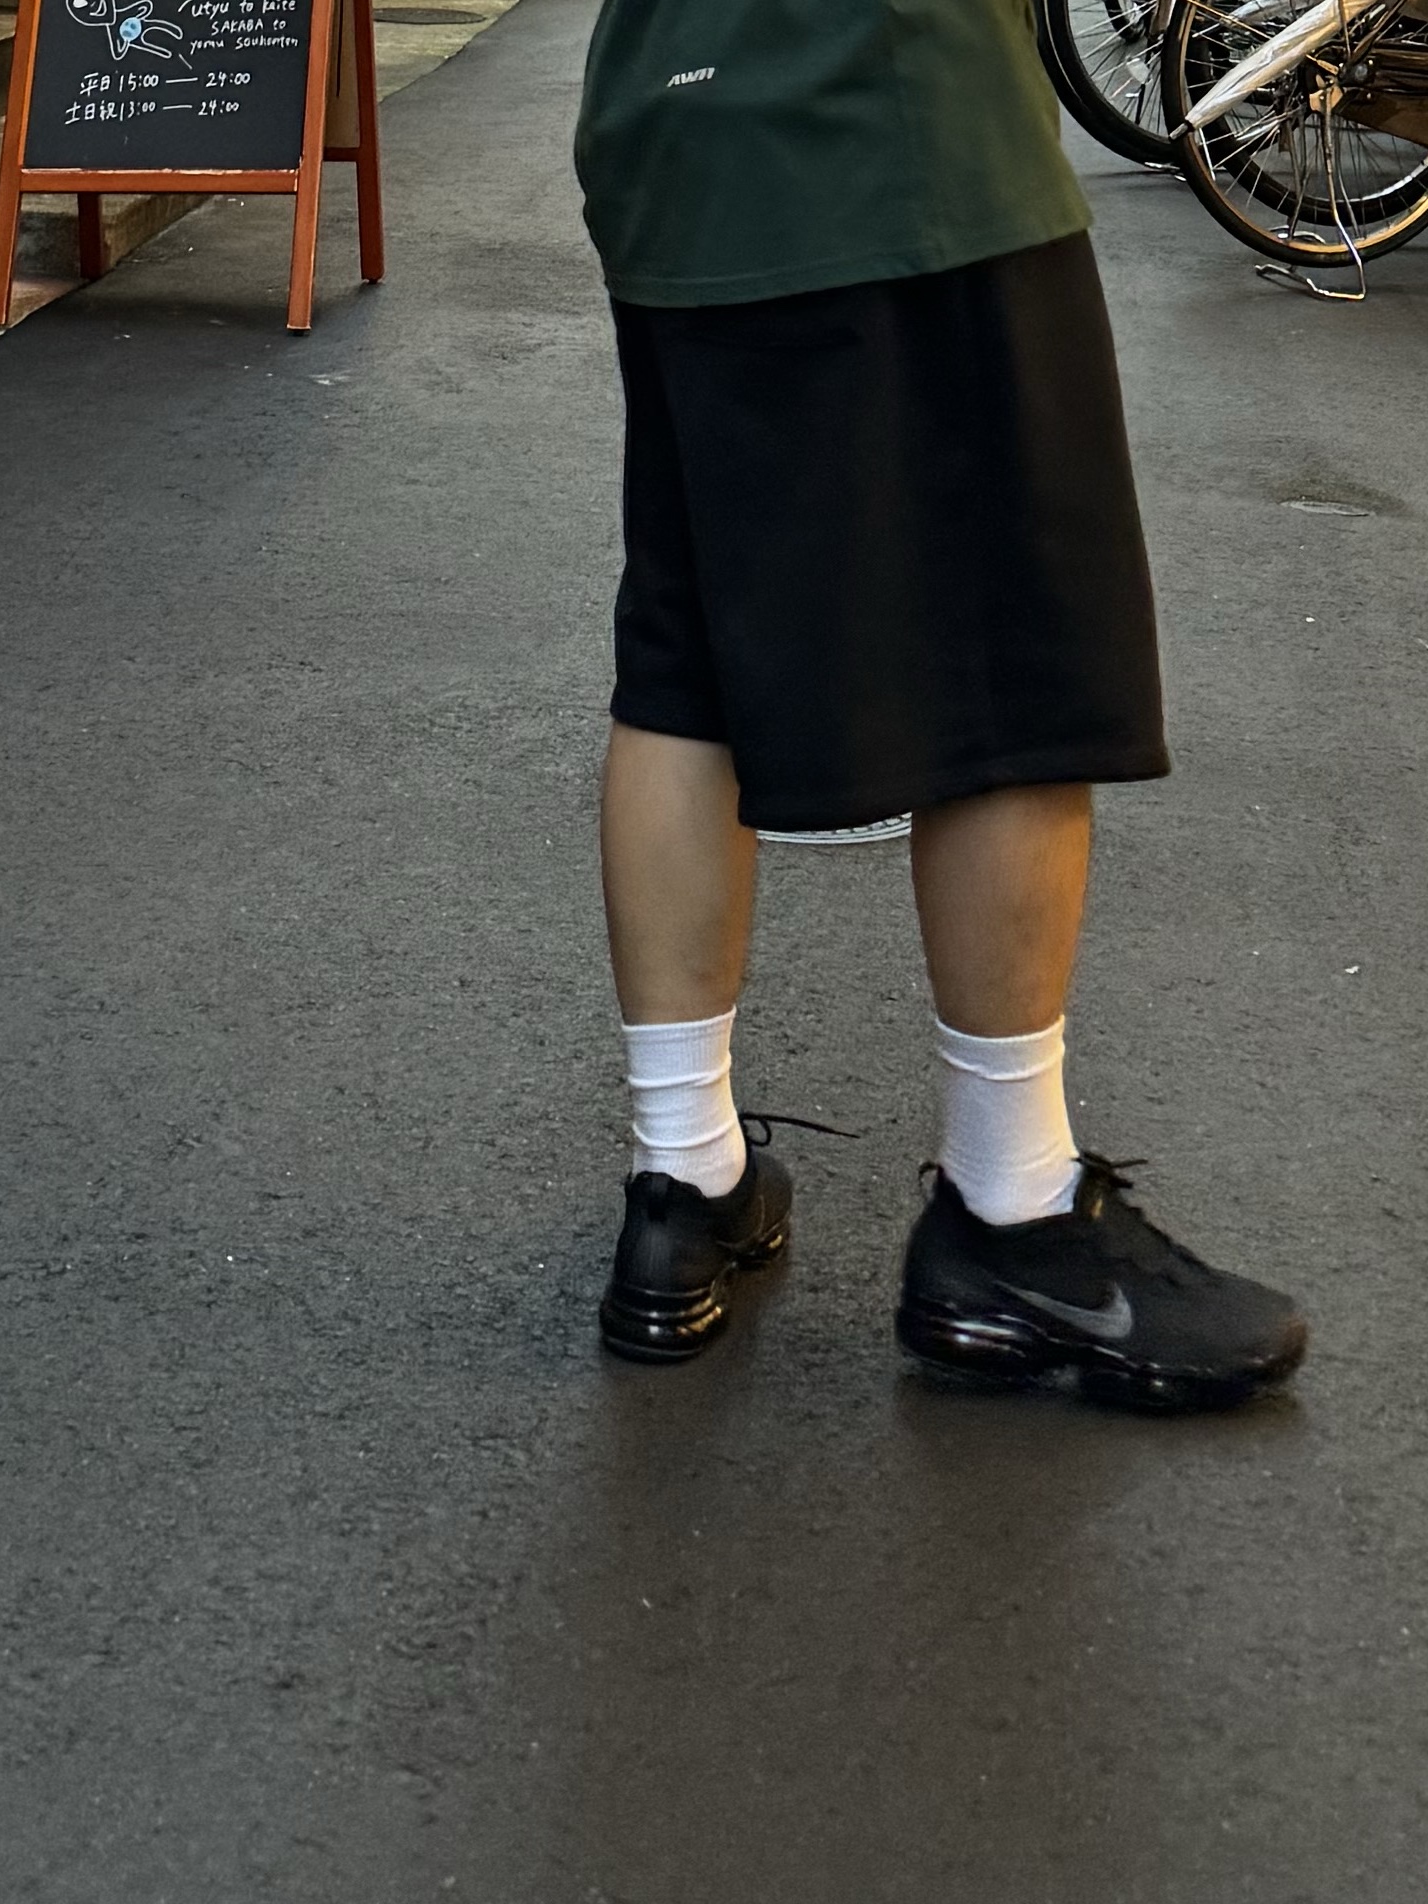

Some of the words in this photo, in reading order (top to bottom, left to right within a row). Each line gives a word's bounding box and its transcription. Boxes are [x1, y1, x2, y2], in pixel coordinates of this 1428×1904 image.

[210, 19, 264, 36] SAKABA
[205, 72, 251, 88] 24:00
[198, 100, 240, 116] 24:00
